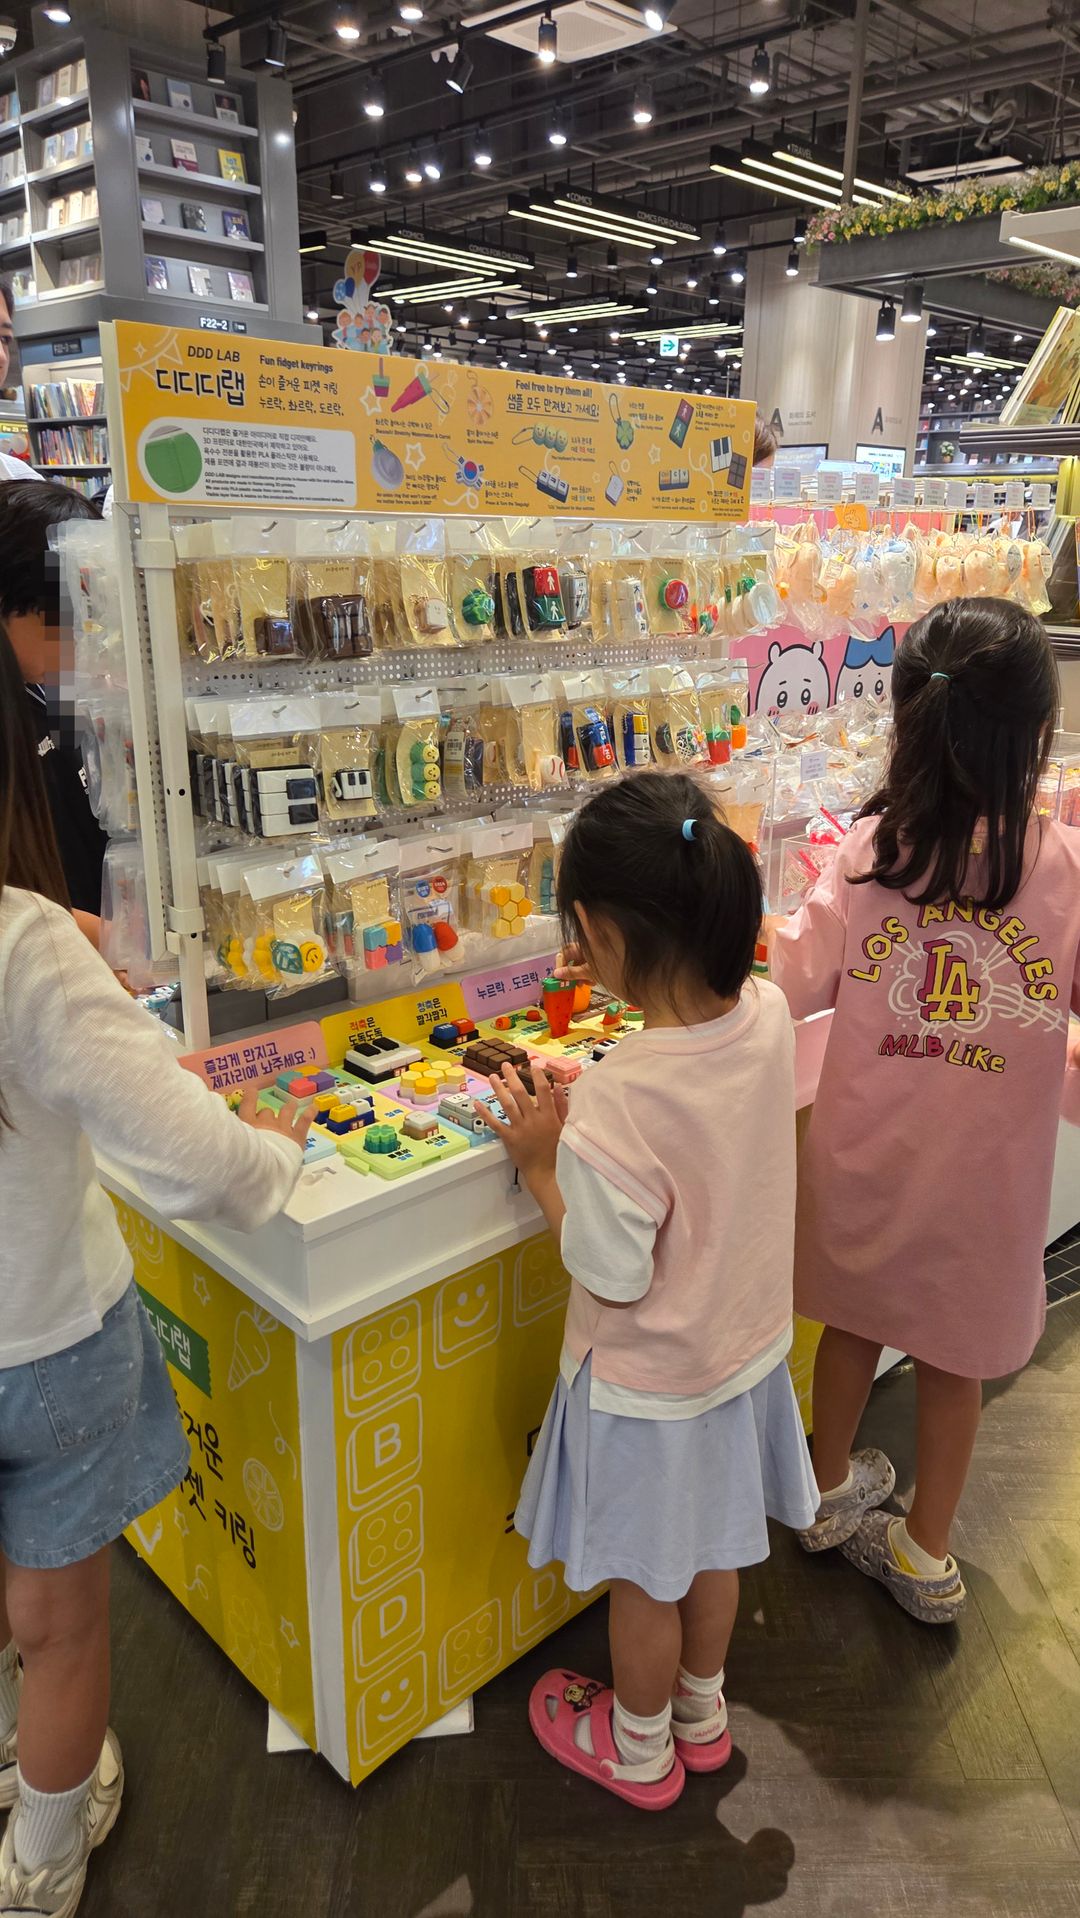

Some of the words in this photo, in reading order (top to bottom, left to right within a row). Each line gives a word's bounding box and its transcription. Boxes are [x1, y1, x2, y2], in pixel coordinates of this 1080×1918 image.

[570, 193, 592, 206] COMICS
[637, 211, 657, 223] COMICS
[657, 215, 669, 226] FOR
[402, 229, 424, 241] COMICS
[468, 244, 489, 255] COMICS
[490, 248, 501, 258] FOR
[200, 317, 228, 331] F22-2
[187, 345, 213, 360] DDD
[216, 348, 241, 362] LAB
[259, 355, 275, 367] Fun
[276, 357, 298, 370] fidget
[300, 359, 334, 374] keyrings
[155, 368, 245, 407] 디디디랩
[258, 374, 275, 388] 손이
[278, 375, 301, 392] 즐거운
[303, 380, 321, 394] 피젯
[324, 382, 338, 396] 키링
[516, 379, 531, 390] Feel
[531, 382, 546, 392] free
[546, 384, 553, 393] to
[554, 385, 565, 396] try
[565, 386, 582, 396] them
[582, 388, 593, 398] all!
[507, 393, 523, 412] 샘플
[527, 397, 541, 412] 모두
[543, 397, 572, 414] 만져보고
[575, 403, 600, 418] 가세요!
[769, 408, 784, 437] A
[871, 406, 884, 435] A
[203, 427, 231, 437] 디디디랩은
[232, 430, 248, 438] 즐거운
[204, 447, 221, 456] 옥수수
[258, 451, 270, 459] PLA
[599, 725, 607, 741] YES
[604, 748, 612, 761] NO
[847, 916, 910, 984] LOS
[917, 896, 1058, 1001] ANGELES
[476, 981, 505, 1000] 누르락
[512, 971, 540, 990] 도르락
[917, 938, 981, 1022] LA
[348, 1016, 376, 1032] 적축은
[878, 1034, 944, 1059] MLB
[203, 1052, 240, 1075] 즐겁게
[244, 1041, 279, 1062] 만지고
[209, 1064, 259, 1090] 제자리에
[260, 1052, 306, 1078] 놔주세요
[373, 1422, 401, 1469] B
[179, 1466, 207, 1521] 젯
[214, 1499, 256, 1569] 키링
[379, 1594, 407, 1640] D
